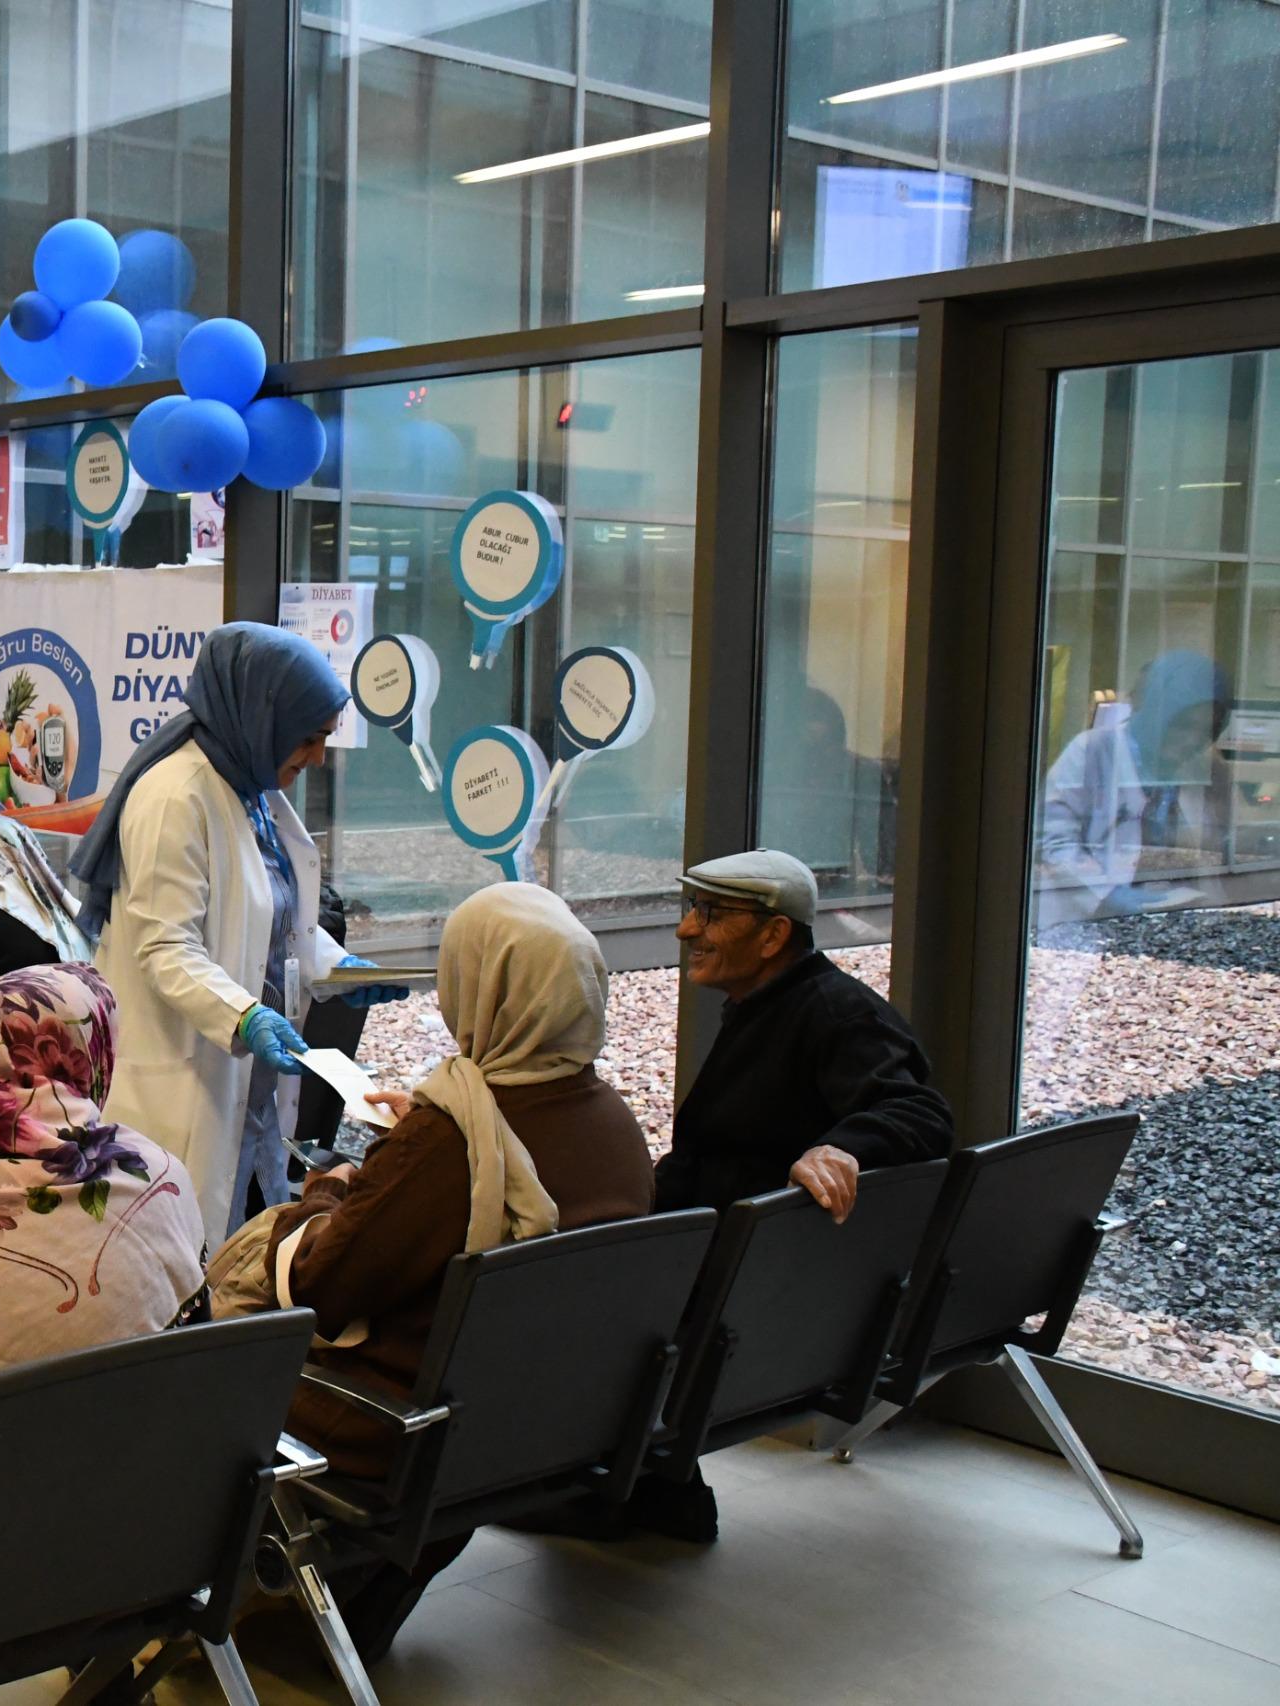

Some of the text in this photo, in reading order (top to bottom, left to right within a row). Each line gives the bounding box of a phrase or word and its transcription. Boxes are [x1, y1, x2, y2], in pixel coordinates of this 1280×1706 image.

[482, 526, 529, 546] ABUR CUBUR
[312, 587, 352, 601] DİYABET
[31, 633, 84, 685] Beslen
[112, 668, 194, 702] DİYA
[467, 784, 492, 801] FARKET
